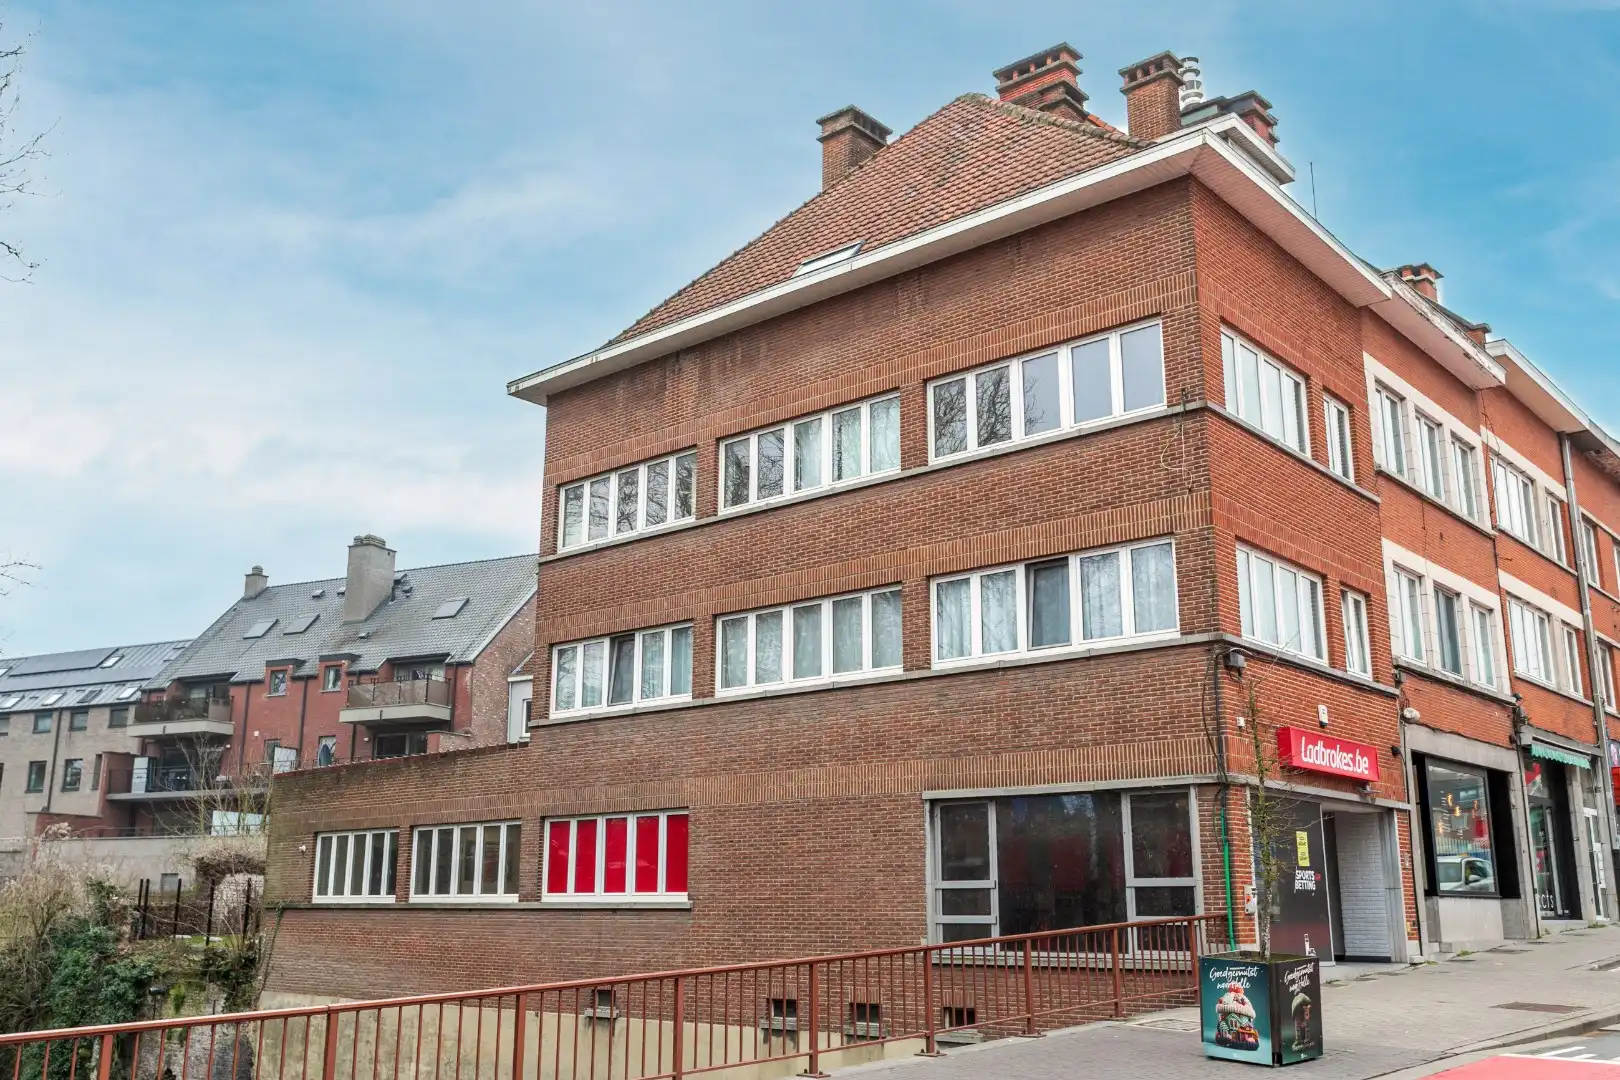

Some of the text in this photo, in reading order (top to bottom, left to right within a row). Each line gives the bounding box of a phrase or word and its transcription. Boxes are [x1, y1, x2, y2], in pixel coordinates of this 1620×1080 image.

[1301, 736, 1369, 774] Ladbrokes.be
[1295, 870, 1315, 881] SPORTS
[1295, 880, 1316, 891] BETTING
[1209, 966, 1259, 982] Goedgemutst
